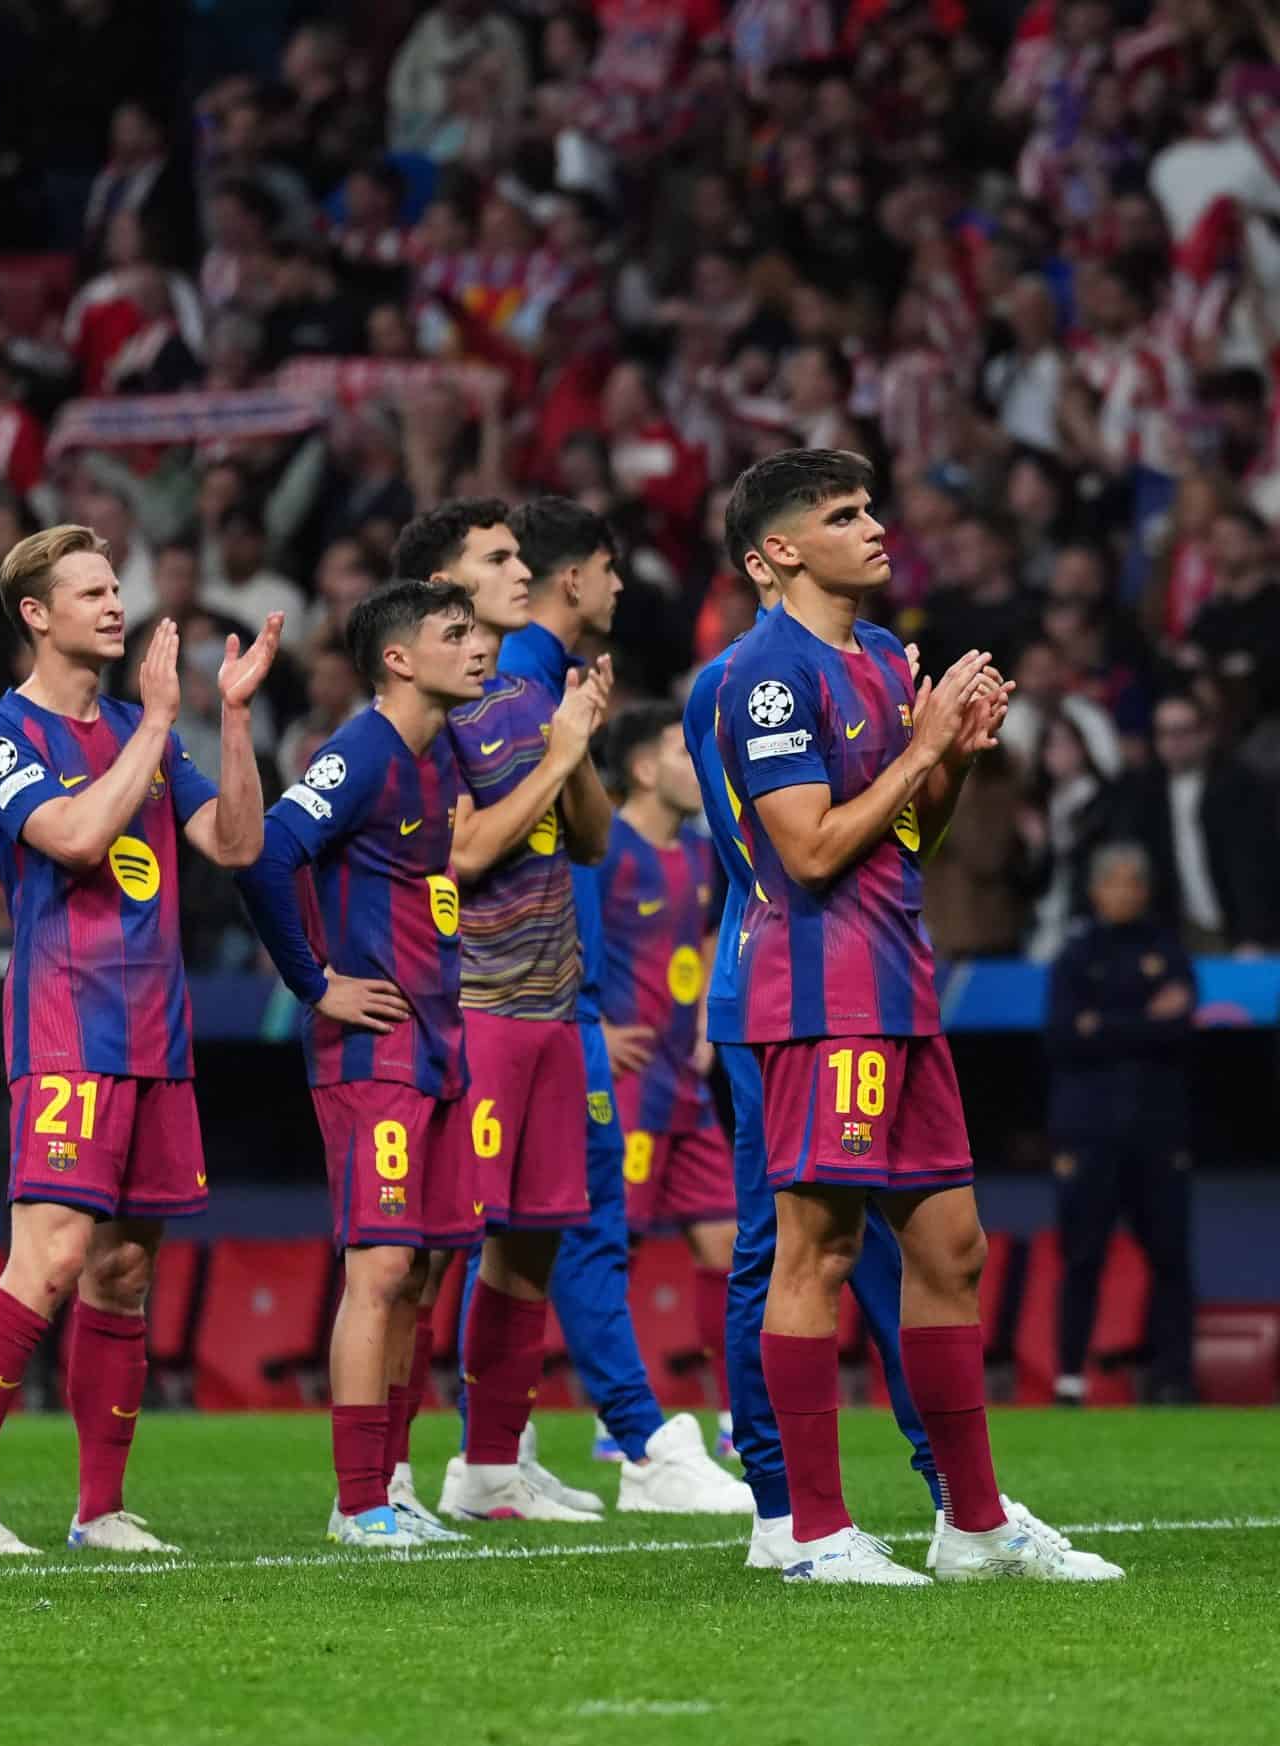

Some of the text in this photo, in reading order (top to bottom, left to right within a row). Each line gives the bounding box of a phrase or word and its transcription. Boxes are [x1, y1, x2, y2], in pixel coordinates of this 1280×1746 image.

[34, 1074, 99, 1140] 21
[828, 1048, 886, 1117] 18
[373, 1119, 409, 1181] 8
[471, 1098, 502, 1159] 6
